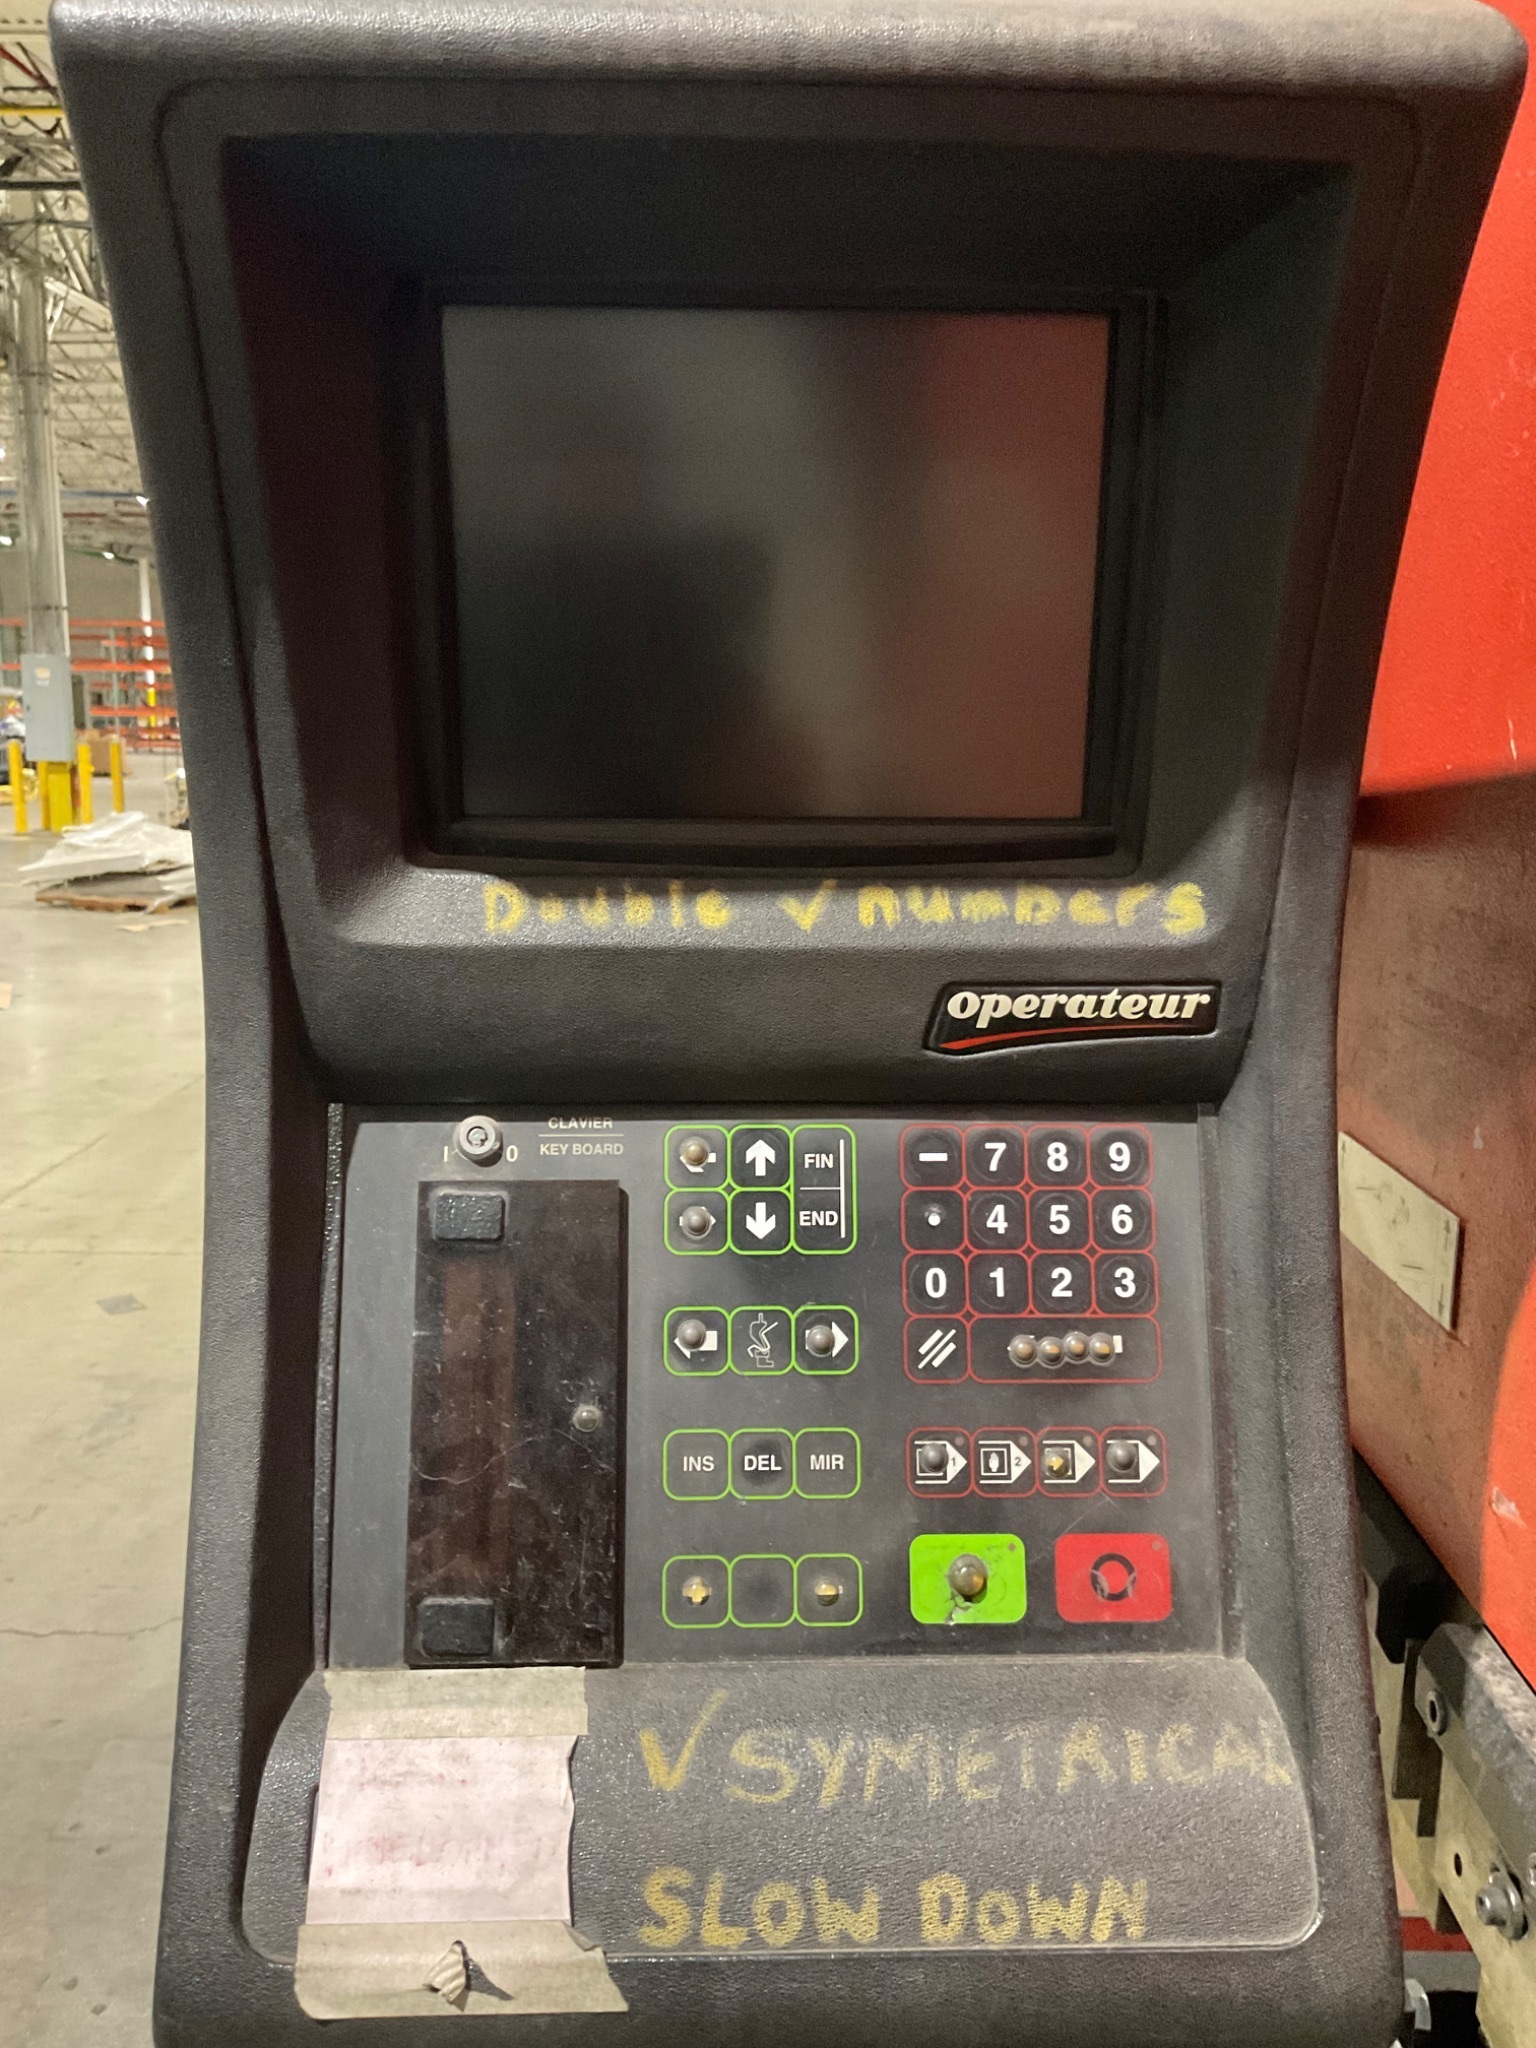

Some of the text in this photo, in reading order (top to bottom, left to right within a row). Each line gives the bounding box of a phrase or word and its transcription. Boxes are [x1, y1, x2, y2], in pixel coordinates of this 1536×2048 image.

[548, 1117, 613, 1129] CLAVIER
[539, 1143, 624, 1155] KEY BOARD
[804, 1153, 834, 1169] FIN
[984, 1142, 1007, 1172] 7
[1046, 1141, 1069, 1172] 8
[1108, 1141, 1131, 1172] 9
[799, 1209, 838, 1226] END
[985, 1204, 1009, 1235] 4
[1048, 1204, 1072, 1235] 5
[1110, 1203, 1134, 1235] 6
[924, 1267, 948, 1299] 0
[988, 1266, 1005, 1298] 1
[1050, 1266, 1073, 1298] 2
[1113, 1266, 1137, 1298] 3
[682, 1455, 716, 1472] INS
[742, 1455, 783, 1472] DEL
[809, 1454, 845, 1471] MIR
[1014, 1456, 1023, 1468] 2
[639, 1866, 881, 1949] SLOW
